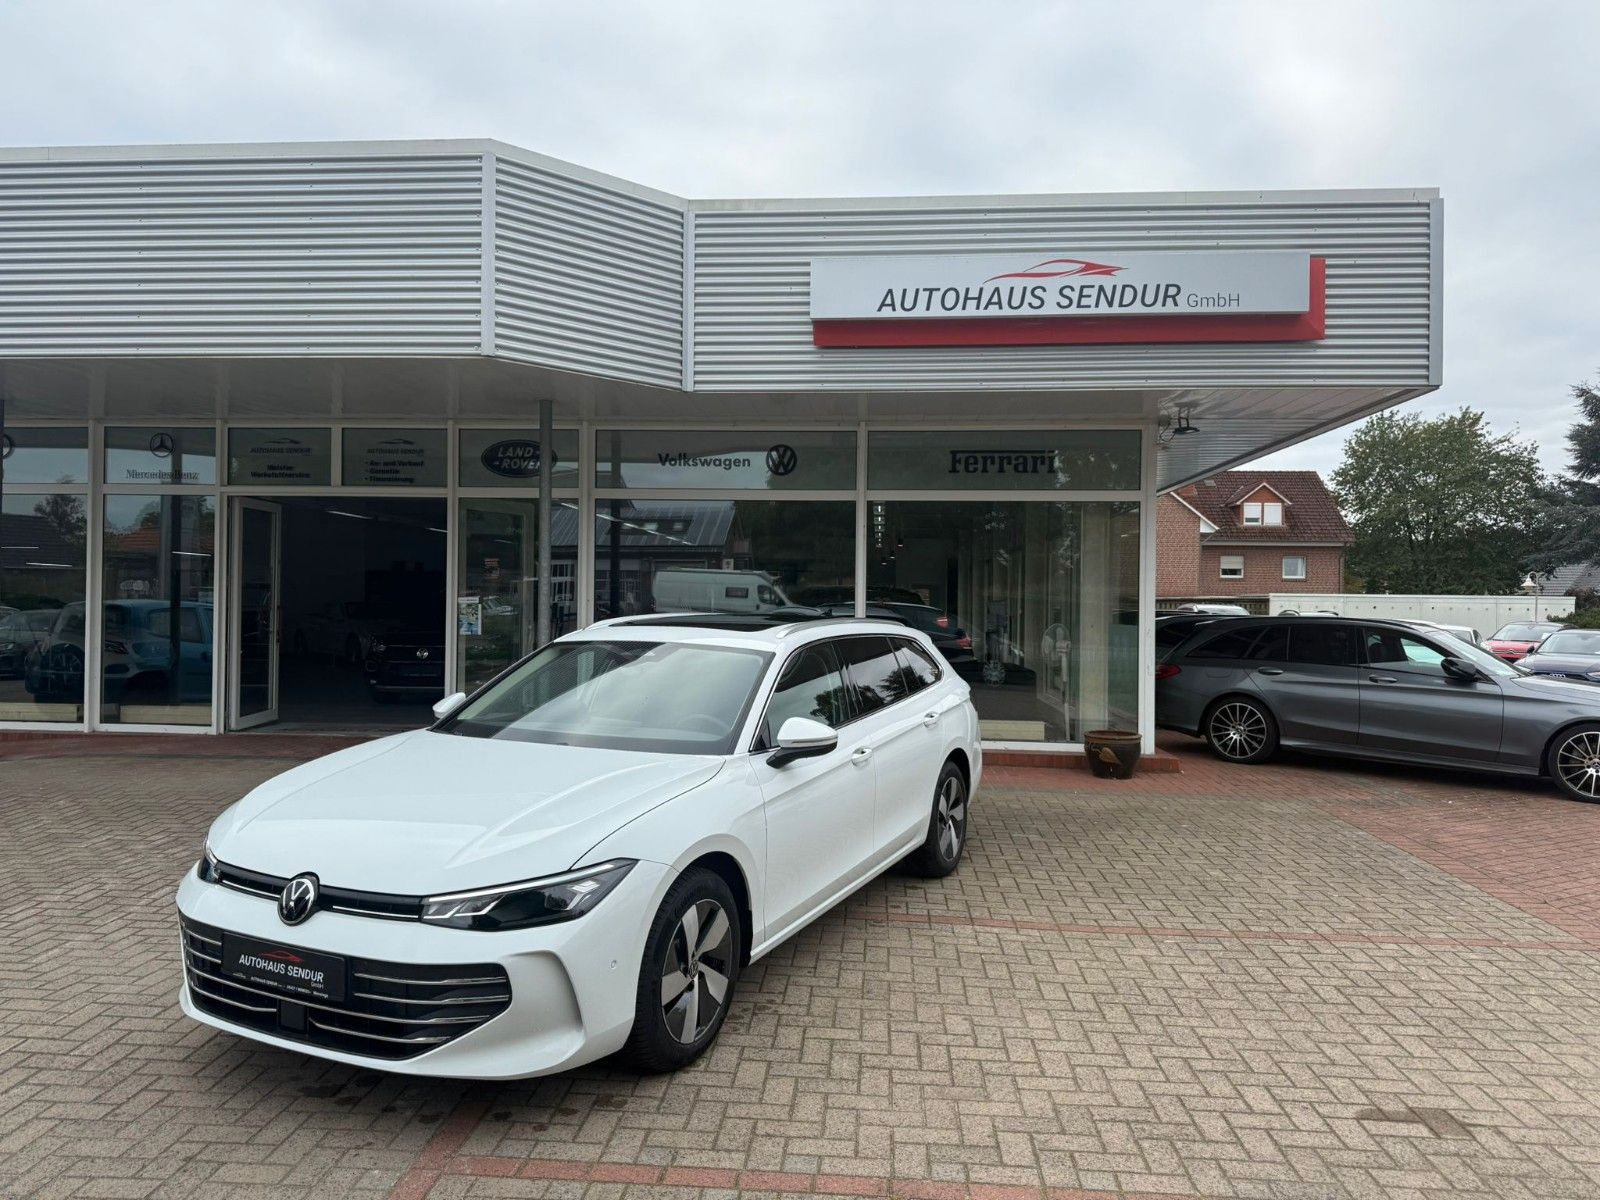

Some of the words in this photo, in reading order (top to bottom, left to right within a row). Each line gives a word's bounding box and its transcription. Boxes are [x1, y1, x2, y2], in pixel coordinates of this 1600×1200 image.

[877, 285, 1048, 313] AUTOHAUS
[1055, 283, 1182, 309] SENDUR
[1186, 293, 1240, 308] GmbH
[498, 446, 533, 457] LAND
[657, 453, 751, 471] Volkswagen
[948, 450, 1056, 474] Ferrari
[238, 954, 286, 974] AUTOHAUS
[287, 965, 324, 983] SENDUR
